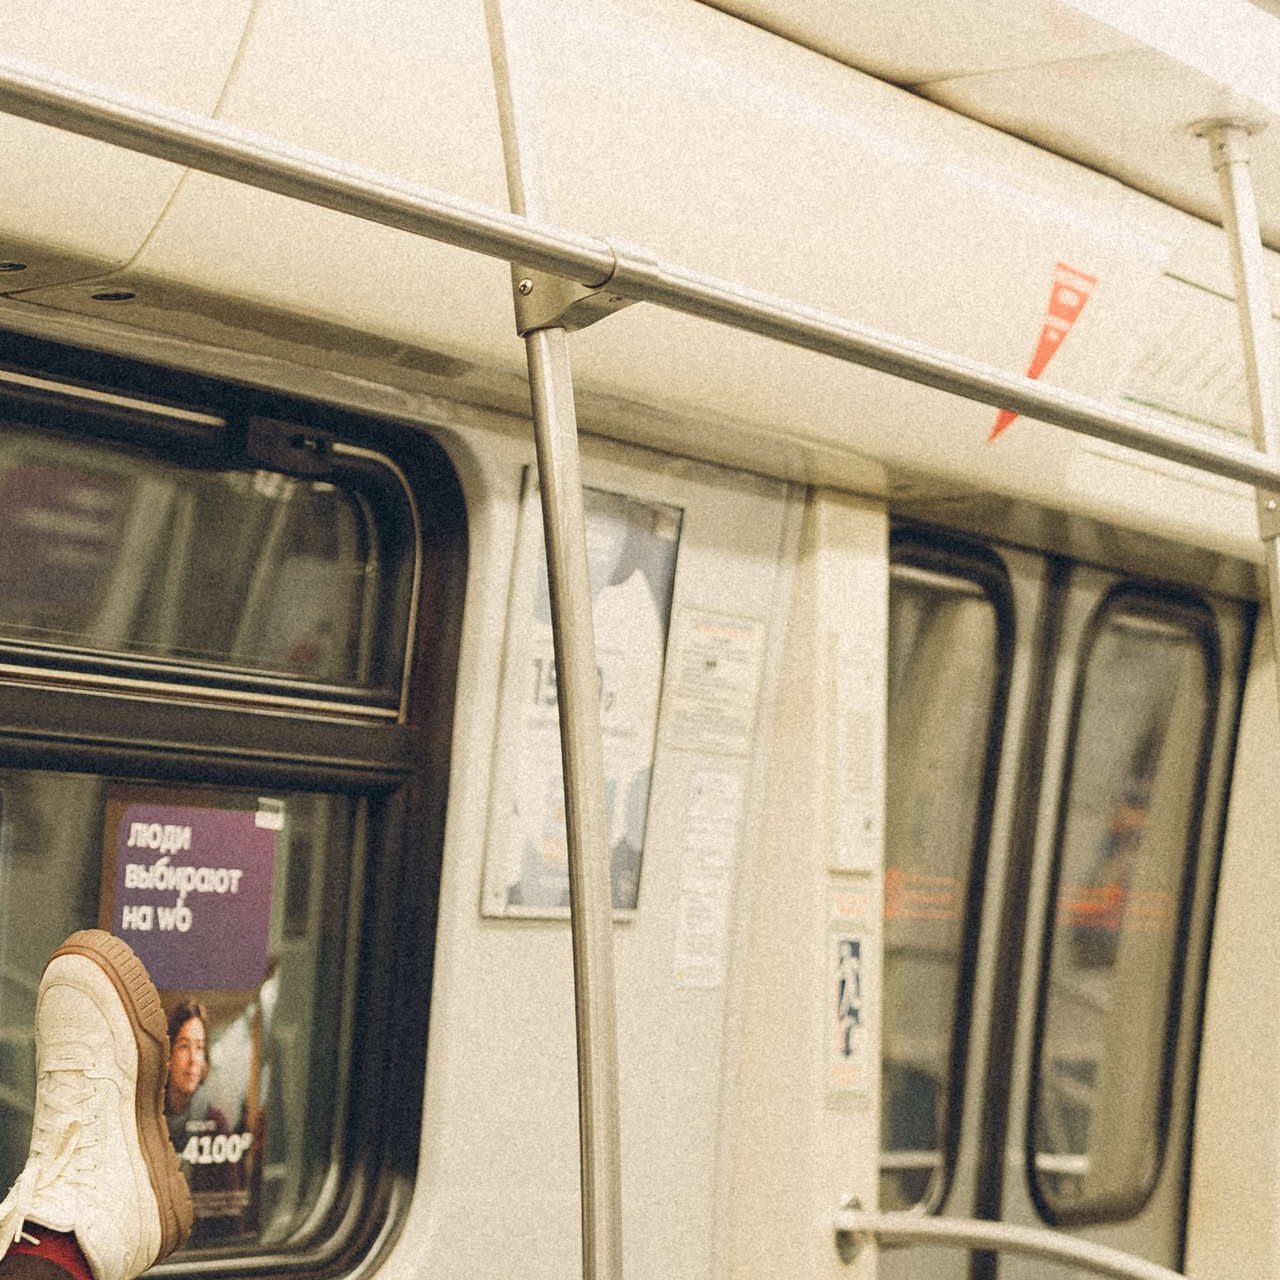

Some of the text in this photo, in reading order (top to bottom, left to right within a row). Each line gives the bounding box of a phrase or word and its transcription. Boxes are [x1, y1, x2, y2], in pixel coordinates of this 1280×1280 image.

[126, 822, 193, 855] люди
[124, 856, 244, 899] выбирают
[121, 905, 155, 932] на
